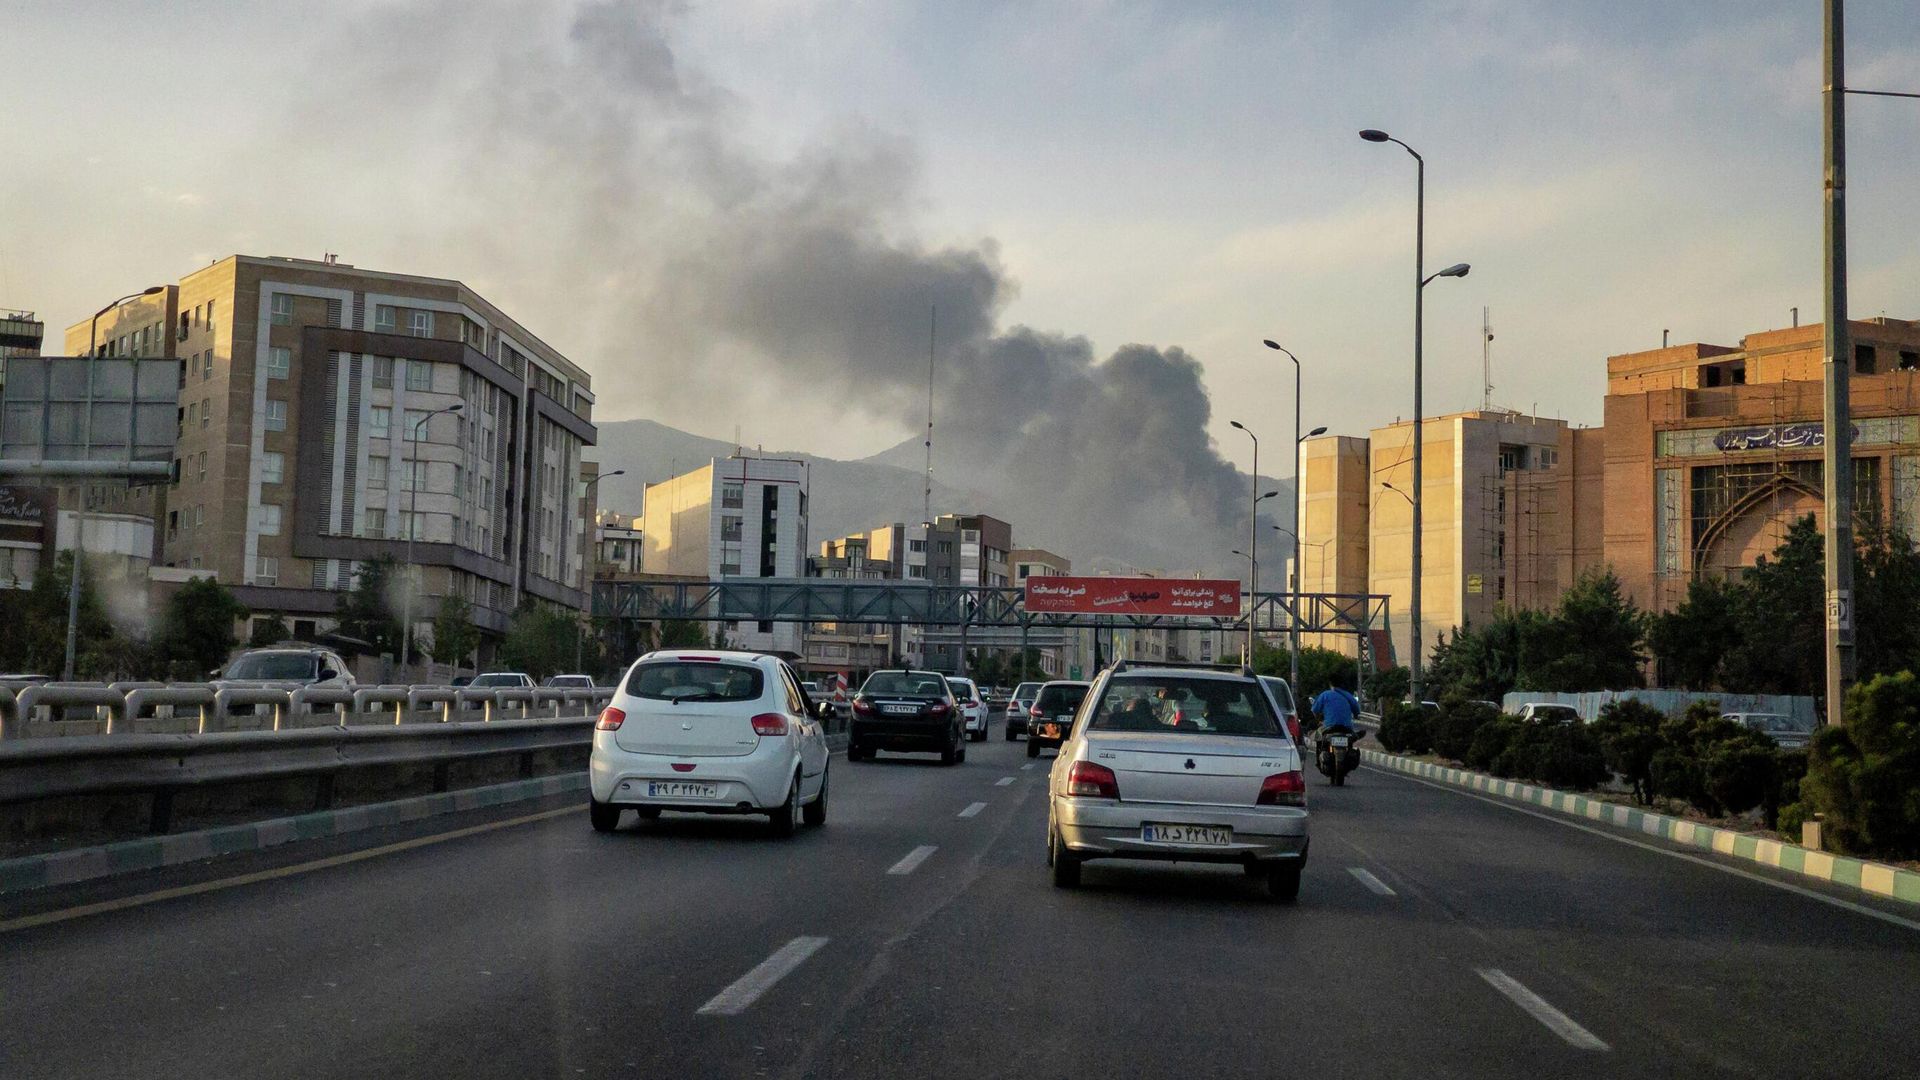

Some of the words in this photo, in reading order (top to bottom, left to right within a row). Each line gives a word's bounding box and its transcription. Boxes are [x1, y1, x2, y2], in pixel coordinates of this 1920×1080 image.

[1777, 426, 1813, 448] فرهنگی
[1031, 584, 1058, 594] سخت
[1059, 584, 1086, 598] ضربه
[1171, 588, 1183, 597] آنها
[1183, 588, 1196, 598] برای
[1196, 588, 1214, 598] زندگی
[1182, 599, 1203, 608] خواهد
[1203, 599, 1214, 609] تلخ
[656, 783, 668, 795] ۲۹
[671, 783, 679, 795] م
[1155, 826, 1169, 840] ۱۸
[1172, 828, 1182, 840] د
[1212, 831, 1227, 844] ۷۸
